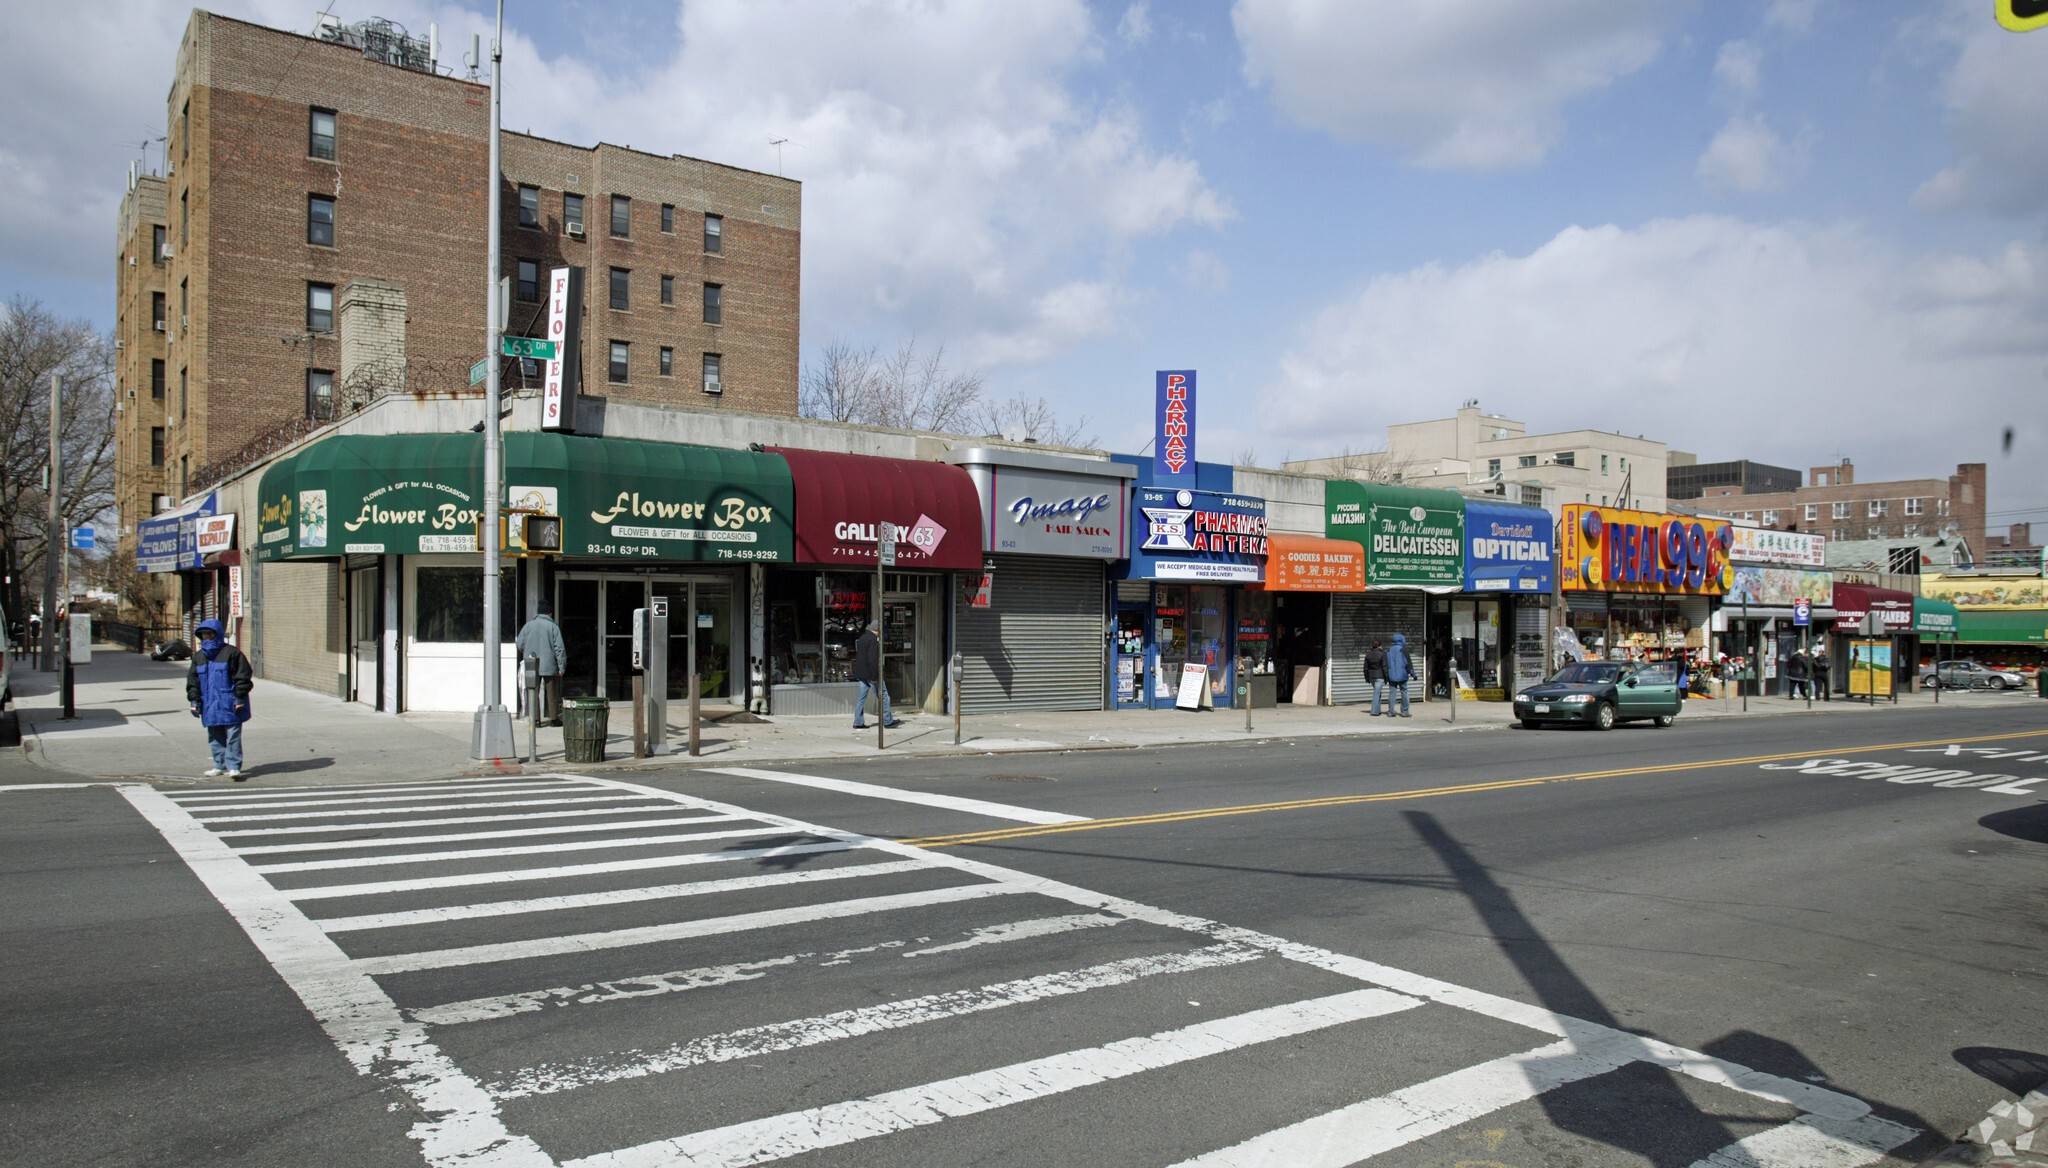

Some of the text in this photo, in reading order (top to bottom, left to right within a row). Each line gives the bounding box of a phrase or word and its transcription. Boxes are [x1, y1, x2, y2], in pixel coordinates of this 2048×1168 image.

[512, 340, 547, 356] 63 DR
[548, 278, 566, 418] FLOWERS
[1165, 374, 1188, 474] PHARMACY
[362, 488, 387, 503] FLOWER
[395, 481, 408, 490] GIFT
[421, 481, 434, 489] ALL
[435, 483, 471, 502] OCCASIONS
[1144, 493, 1163, 501] 93-05
[1011, 494, 1111, 524] Image
[1222, 497, 1236, 506] 718
[1337, 502, 1360, 512] РУССКИЙ
[344, 503, 479, 532] Flower Box
[591, 491, 773, 530] Flower Box
[1195, 510, 1270, 537] PHARMACY
[1331, 513, 1366, 525] МАГАЗИН
[618, 527, 752, 541] FLOWER & GIFT for ALL OCCASIONS
[913, 526, 935, 546] 63
[1046, 524, 1111, 536] HAIR SALON
[1381, 518, 1453, 538] The Best European
[1567, 510, 1575, 561] DEAL
[152, 538, 177, 554] GLOVES
[199, 530, 230, 547] REPAIR
[422, 536, 477, 544] Tel. 718-459-92
[1193, 532, 1269, 556] АПТЕКА
[1373, 534, 1460, 556] DELICATESSEN
[587, 544, 659, 556] 93-01 63rd DR.
[717, 549, 778, 560] 718-459-9292
[1472, 537, 1550, 562] OPTICAL
[1605, 520, 1723, 588] DEAL 99¢
[1288, 552, 1353, 564] GOODIES BAKERY
[965, 575, 990, 588] HAIR
[964, 593, 989, 606] NAIL
[1157, 608, 1184, 616] PHARMACY
[1519, 642, 1543, 651] OPTICAL
[1758, 758, 2048, 796] SCHOOL
